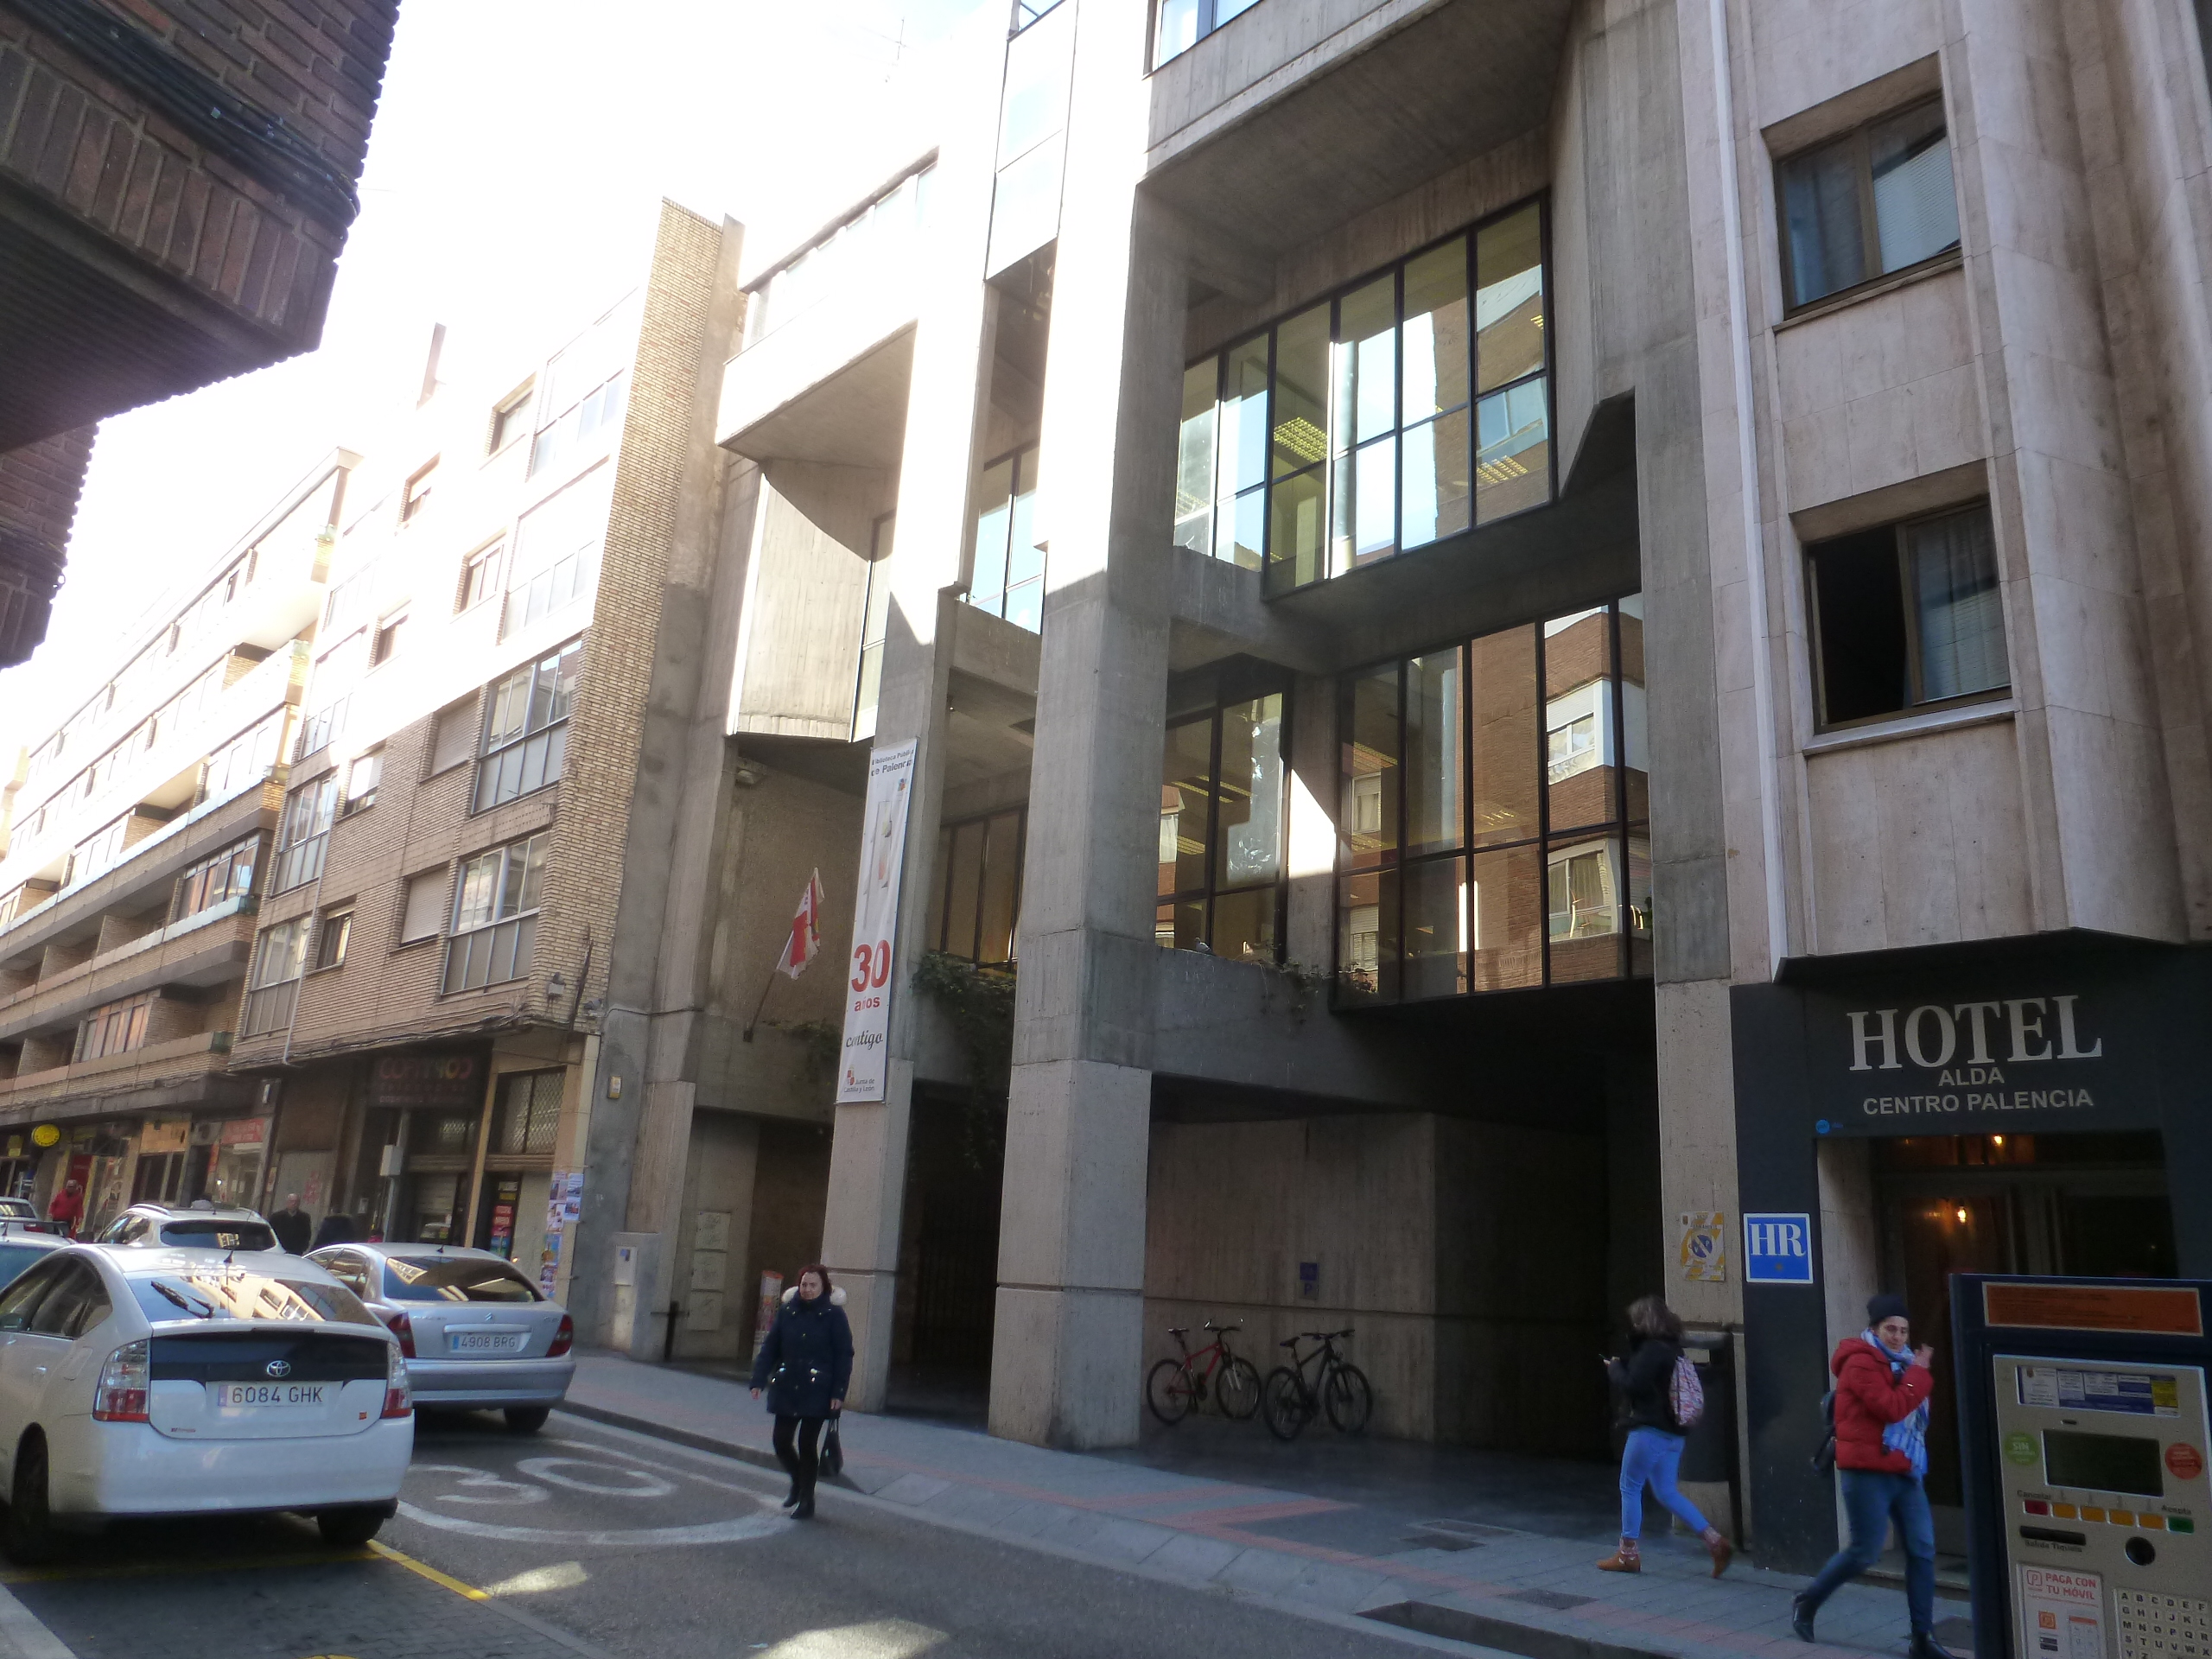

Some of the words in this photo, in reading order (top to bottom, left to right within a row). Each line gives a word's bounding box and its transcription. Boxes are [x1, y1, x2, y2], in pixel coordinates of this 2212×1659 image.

[851, 939, 891, 993] 30
[1846, 994, 2102, 1071] HOTEL
[1938, 1066, 2005, 1087] ALDA
[1863, 1094, 1960, 1116] CENTRO
[1967, 1088, 2094, 1111] PALENCIA
[1749, 1223, 1807, 1257] HR
[461, 1336, 491, 1347] 4908
[493, 1336, 515, 1347] BRG
[232, 1386, 281, 1403] 6084
[289, 1386, 323, 1402] GHK
[2045, 1573, 2072, 1585] PAGA
[2075, 1577, 2096, 1588] CON
[2046, 1585, 2060, 1595] TU
[2063, 1586, 2095, 1599] MÓVIL
[2201, 1633, 2209, 1642] R
[2155, 1640, 2163, 1649] U
[2184, 1645, 2195, 1654] W
